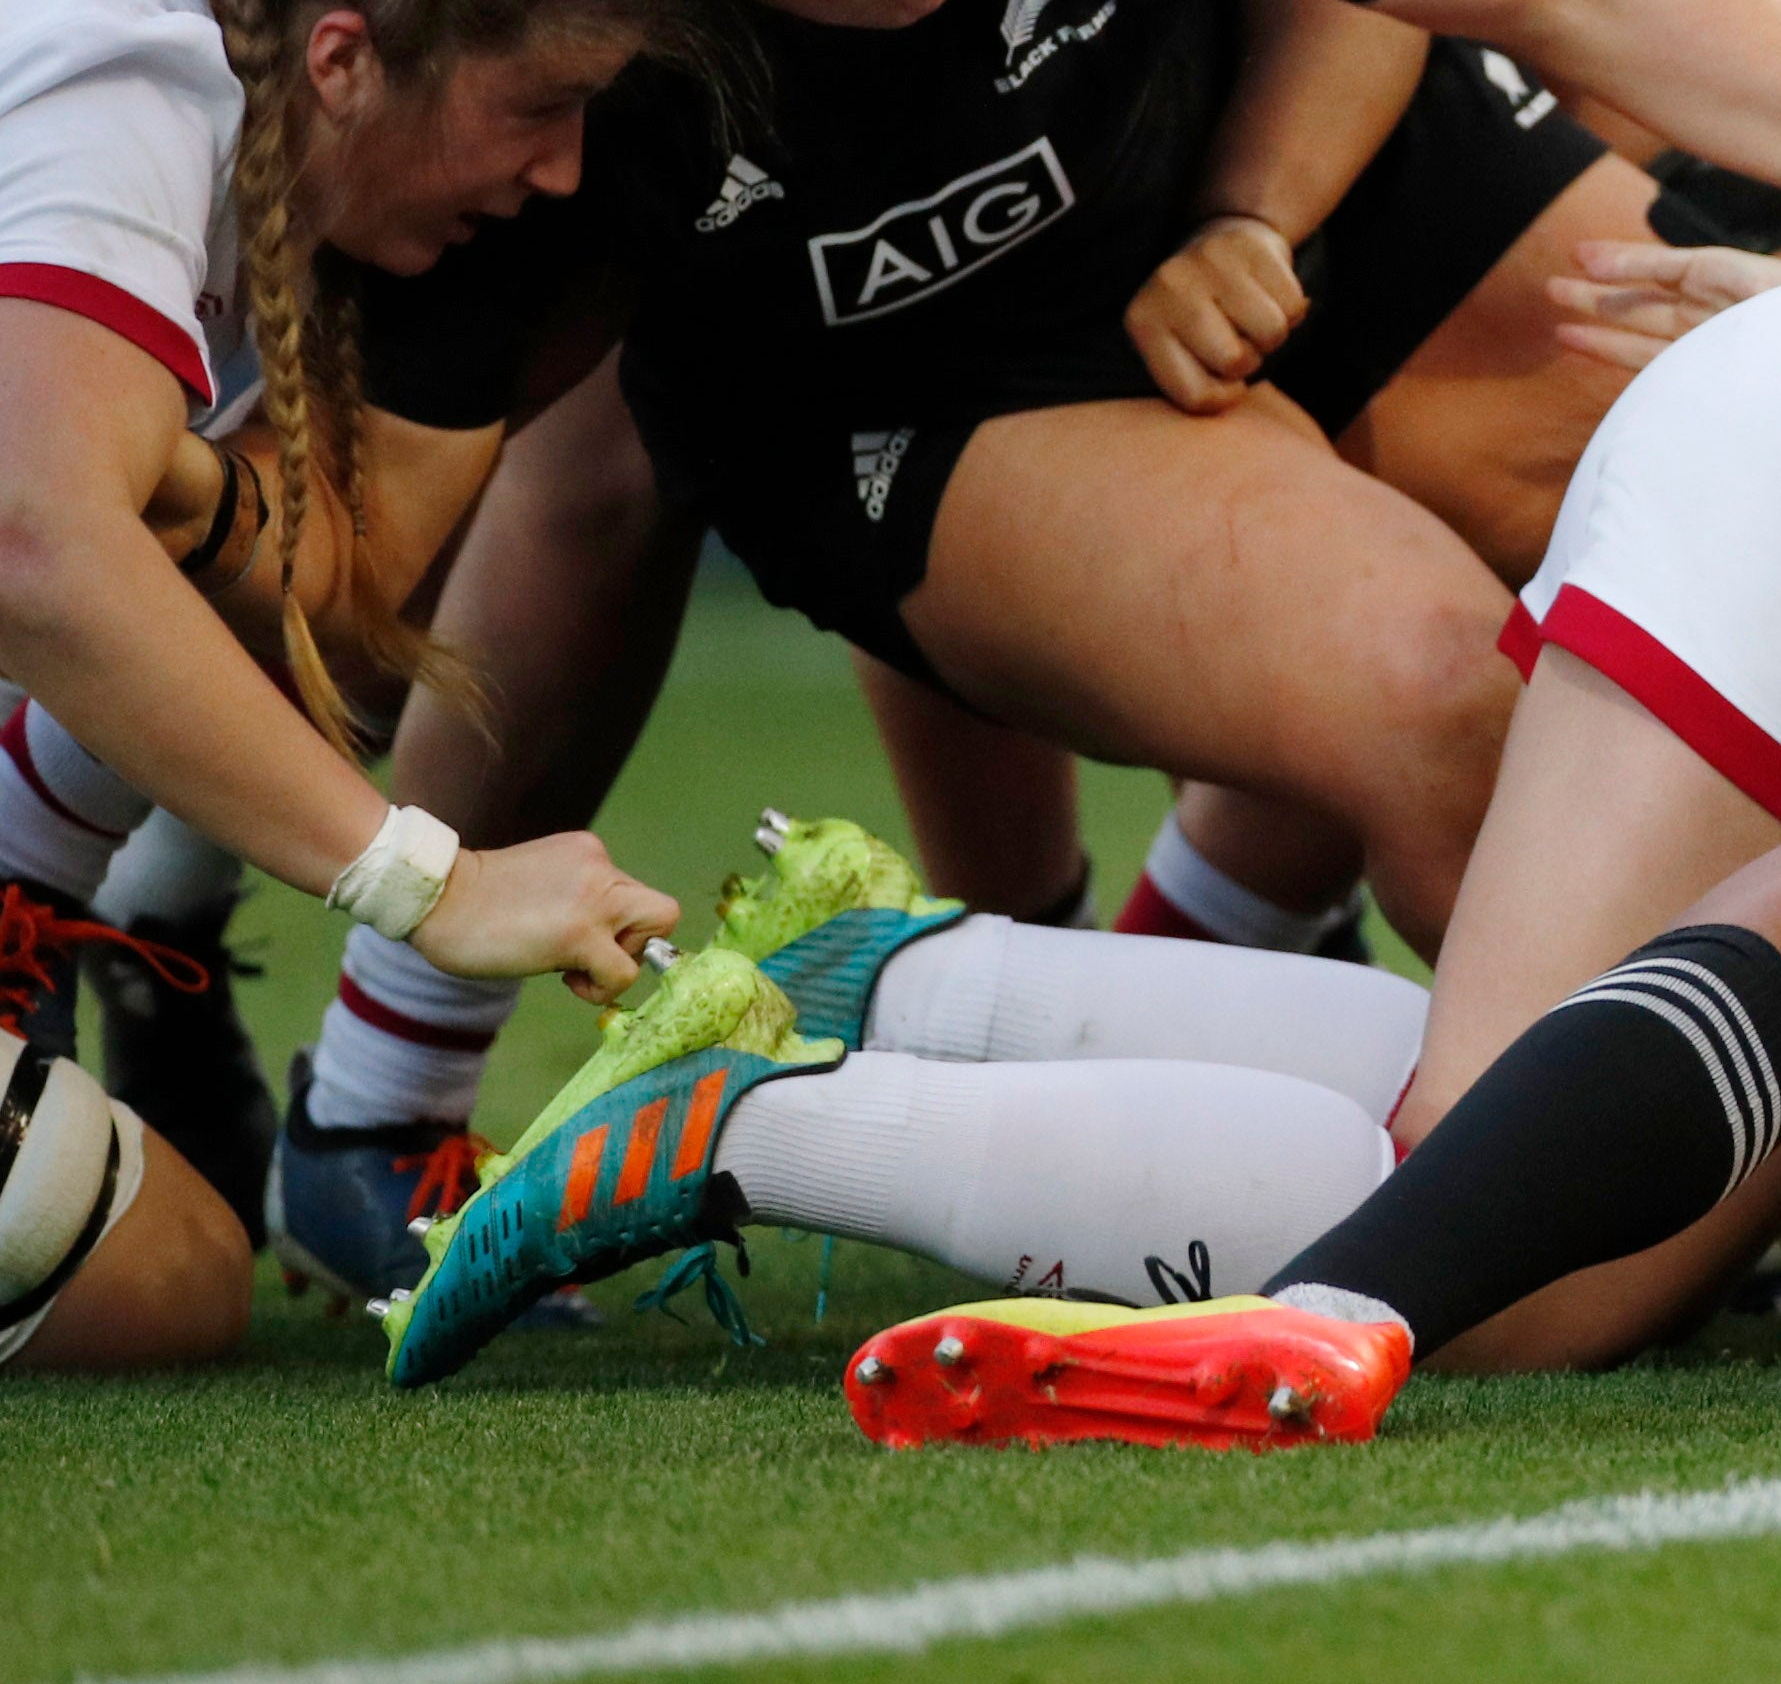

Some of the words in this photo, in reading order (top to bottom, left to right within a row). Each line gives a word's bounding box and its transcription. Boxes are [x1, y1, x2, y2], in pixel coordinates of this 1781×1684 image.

[993, 35, 1059, 94] BLACK
[694, 180, 785, 233] adidas
[857, 180, 1042, 306] AIG
